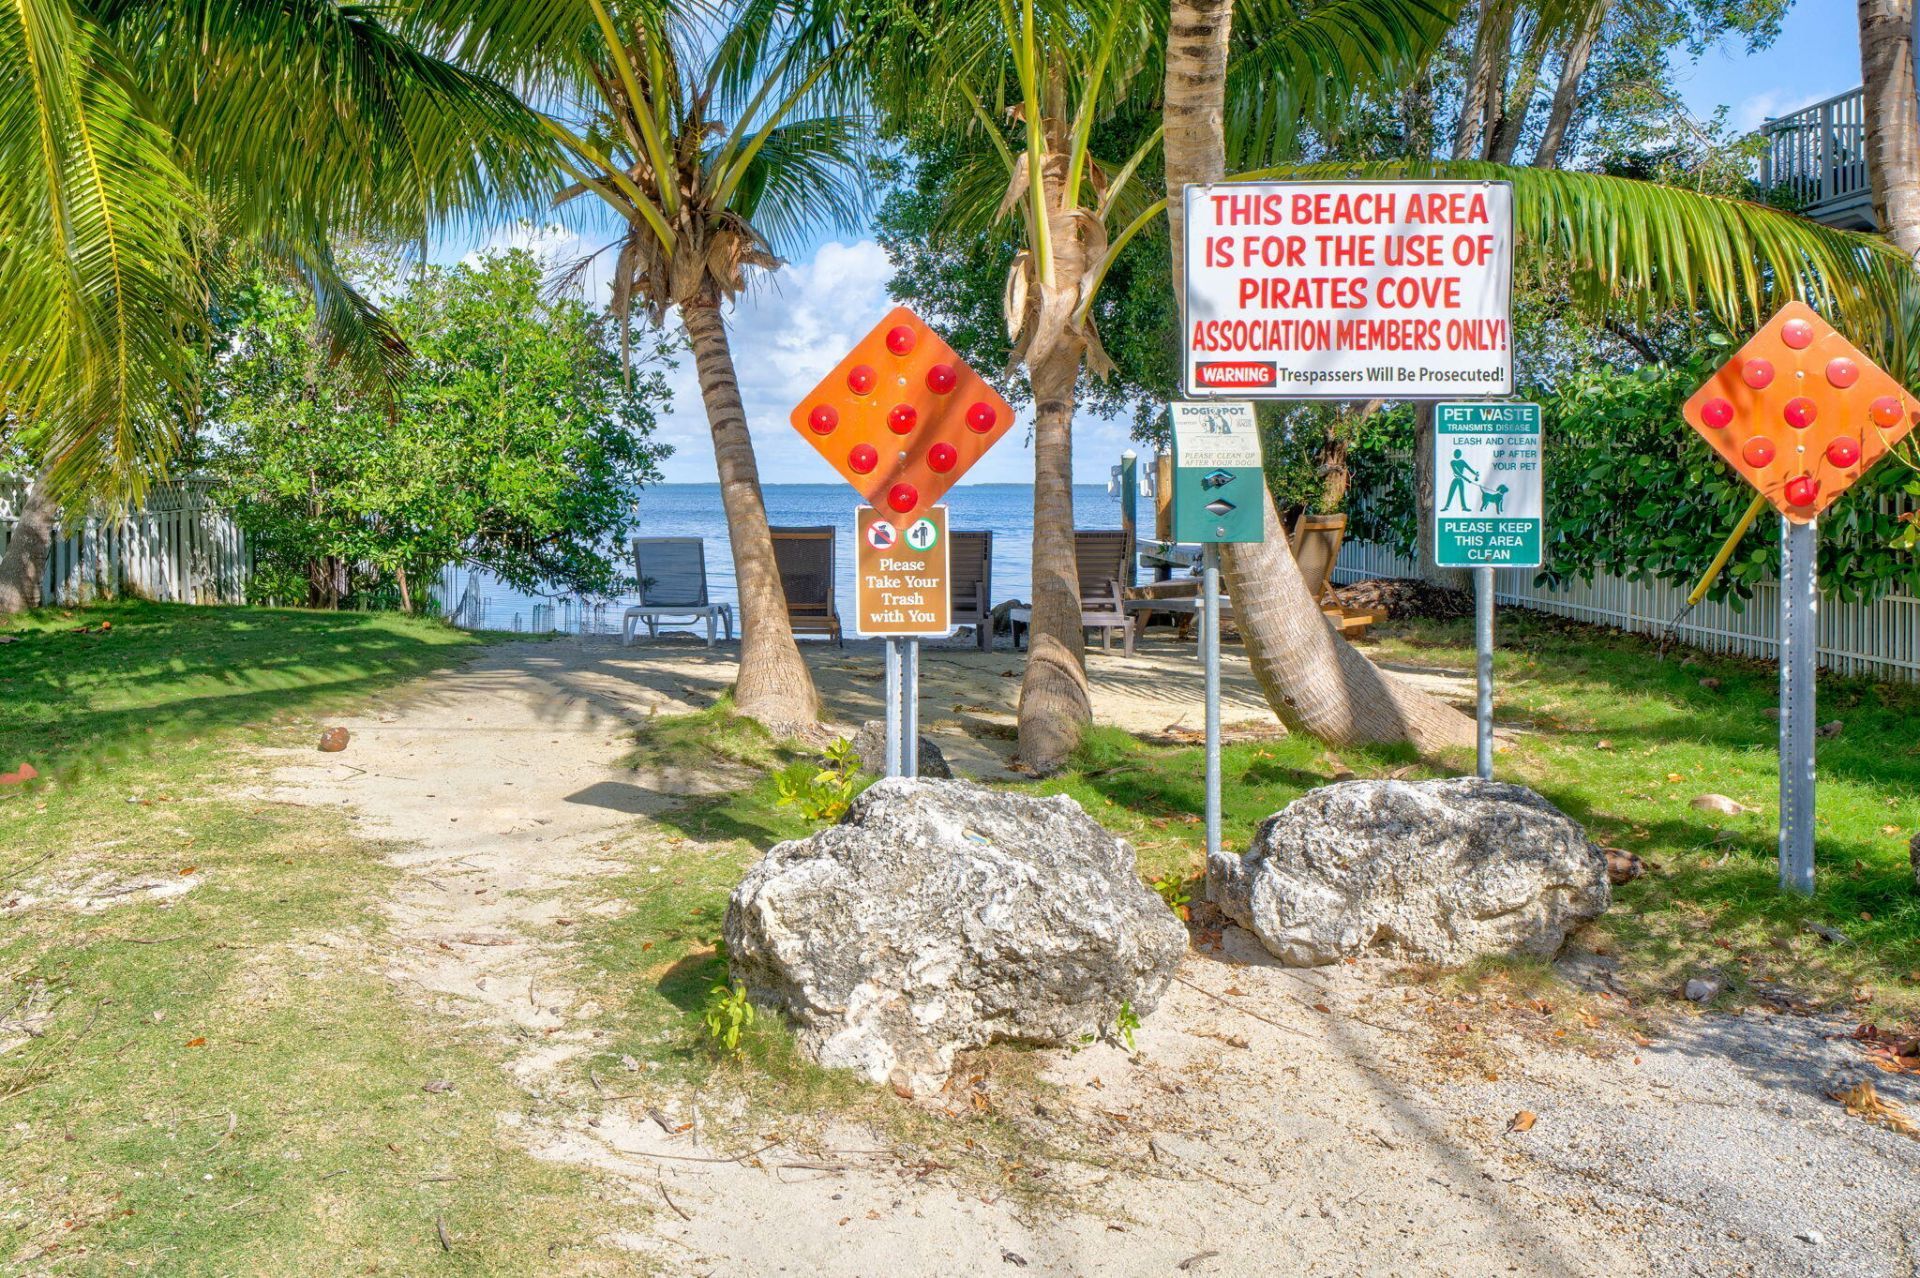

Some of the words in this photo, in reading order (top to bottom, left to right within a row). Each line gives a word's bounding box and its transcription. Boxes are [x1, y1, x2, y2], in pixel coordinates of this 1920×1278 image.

[1211, 194, 1282, 225] THIS
[1292, 194, 1396, 224] BEACH
[1405, 193, 1488, 223] AREA
[1206, 236, 1234, 267] IS
[1244, 236, 1306, 267] FOR
[1315, 236, 1374, 266] THE
[1384, 235, 1443, 266] USE
[1452, 235, 1494, 266] OF
[1239, 277, 1367, 309] PIRATES
[1376, 277, 1460, 308] COVE
[1192, 320, 1331, 351] ASSOCIATION
[1336, 319, 1441, 351] MEMBERS
[1446, 319, 1506, 350] ONLY!
[1203, 367, 1269, 382] WARNING
[1280, 368, 1363, 384] Trespassers
[1366, 367, 1393, 381] Will
[1397, 367, 1415, 381] Be
[1419, 367, 1504, 384] Prosecuted!
[1444, 408, 1473, 421] PET
[1480, 408, 1533, 421] WASTE
[1453, 437, 1482, 445] LEASH
[1486, 437, 1504, 445] AND
[1508, 437, 1537, 445] CLEAN
[1493, 450, 1505, 458] UP
[1509, 450, 1537, 458] AFTER
[1445, 522, 1493, 533] PLEASE
[1499, 522, 1532, 533] KEEP
[1455, 536, 1483, 546] THIS
[1489, 536, 1523, 546] AREA
[1467, 549, 1510, 560] CLEAN
[880, 558, 925, 571] Please
[866, 576, 901, 588] Take
[904, 576, 939, 588] Your
[881, 592, 924, 605] Trash
[870, 610, 904, 622] with
[908, 610, 936, 622] You
